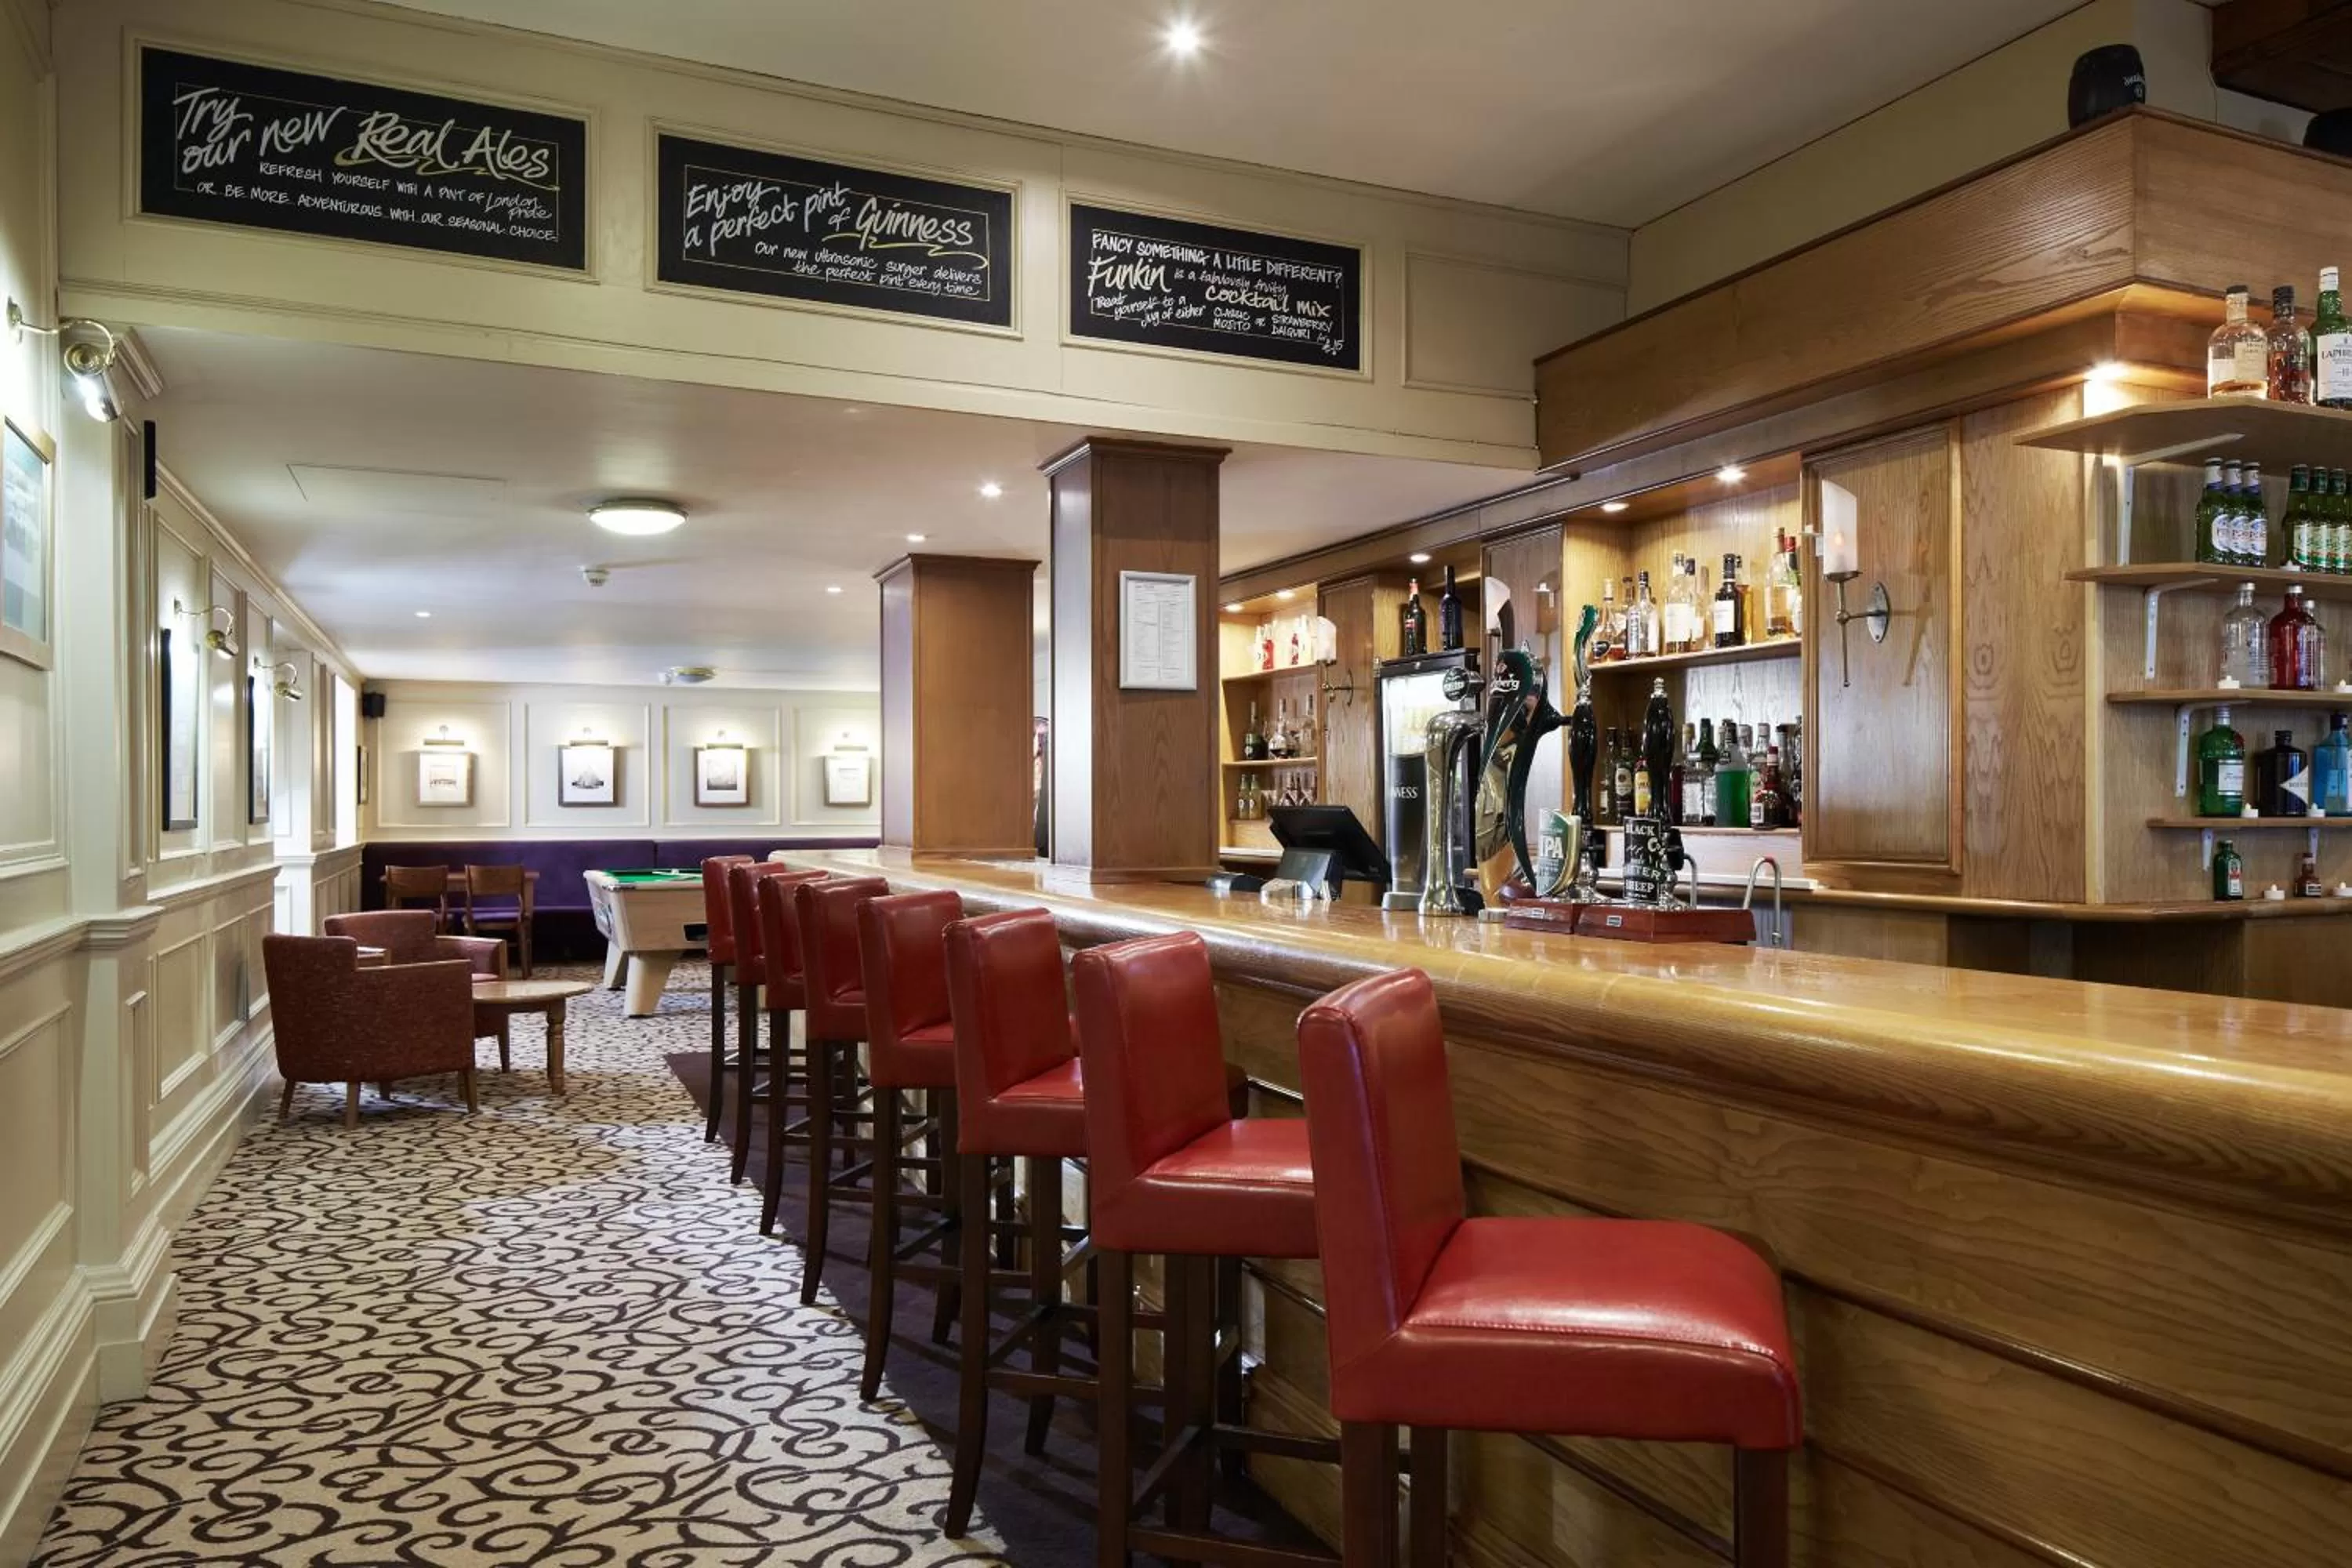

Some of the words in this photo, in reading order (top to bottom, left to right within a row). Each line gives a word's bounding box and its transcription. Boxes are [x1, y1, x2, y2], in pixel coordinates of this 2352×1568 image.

[172, 87, 254, 143] Try
[182, 129, 251, 174] our
[259, 106, 347, 157] new
[351, 111, 459, 169] Real
[462, 126, 549, 180] Ales
[197, 181, 215, 195] OR
[224, 184, 245, 198] BE
[250, 187, 290, 205] MORE
[297, 194, 383, 217] ADVENTUROUS
[390, 207, 415, 222] WITH
[420, 212, 445, 226] OUR
[448, 216, 506, 234] SEASONAL
[260, 162, 322, 183] REFRESH
[332, 172, 390, 191] YOURSELF
[396, 179, 418, 196] WITH
[423, 184, 433, 197] A
[468, 191, 485, 205] OF
[485, 193, 543, 213] London
[686, 180, 782, 220] Enjoy
[684, 224, 703, 249] a
[709, 194, 800, 258] perfect
[804, 180, 851, 233] pint
[827, 206, 851, 232] of
[855, 197, 973, 251] Guinness
[754, 241, 779, 256] Our
[783, 246, 808, 260] new
[814, 247, 878, 270] ultrasonic
[885, 260, 928, 279] surger
[934, 266, 982, 285] delivers
[793, 260, 822, 274] the
[825, 266, 877, 283] perfect
[879, 273, 904, 288] pint
[909, 278, 941, 296] every
[944, 281, 980, 296] time
[1087, 255, 1172, 297] Funkin
[1188, 270, 1196, 281] a
[1092, 233, 1134, 253] FANCY
[1136, 241, 1210, 266] SOMETHING
[1213, 252, 1222, 270] A
[1225, 253, 1261, 273] LITTLE
[1266, 260, 1343, 289] DIFFERENT?
[1114, 296, 1160, 321] yourself
[1163, 296, 1174, 307] to
[1178, 296, 1186, 305] a
[1161, 307, 1174, 320] of
[1175, 303, 1207, 319] either
[1205, 285, 1290, 313] Cocktail
[1540, 835, 1563, 858] IPA
